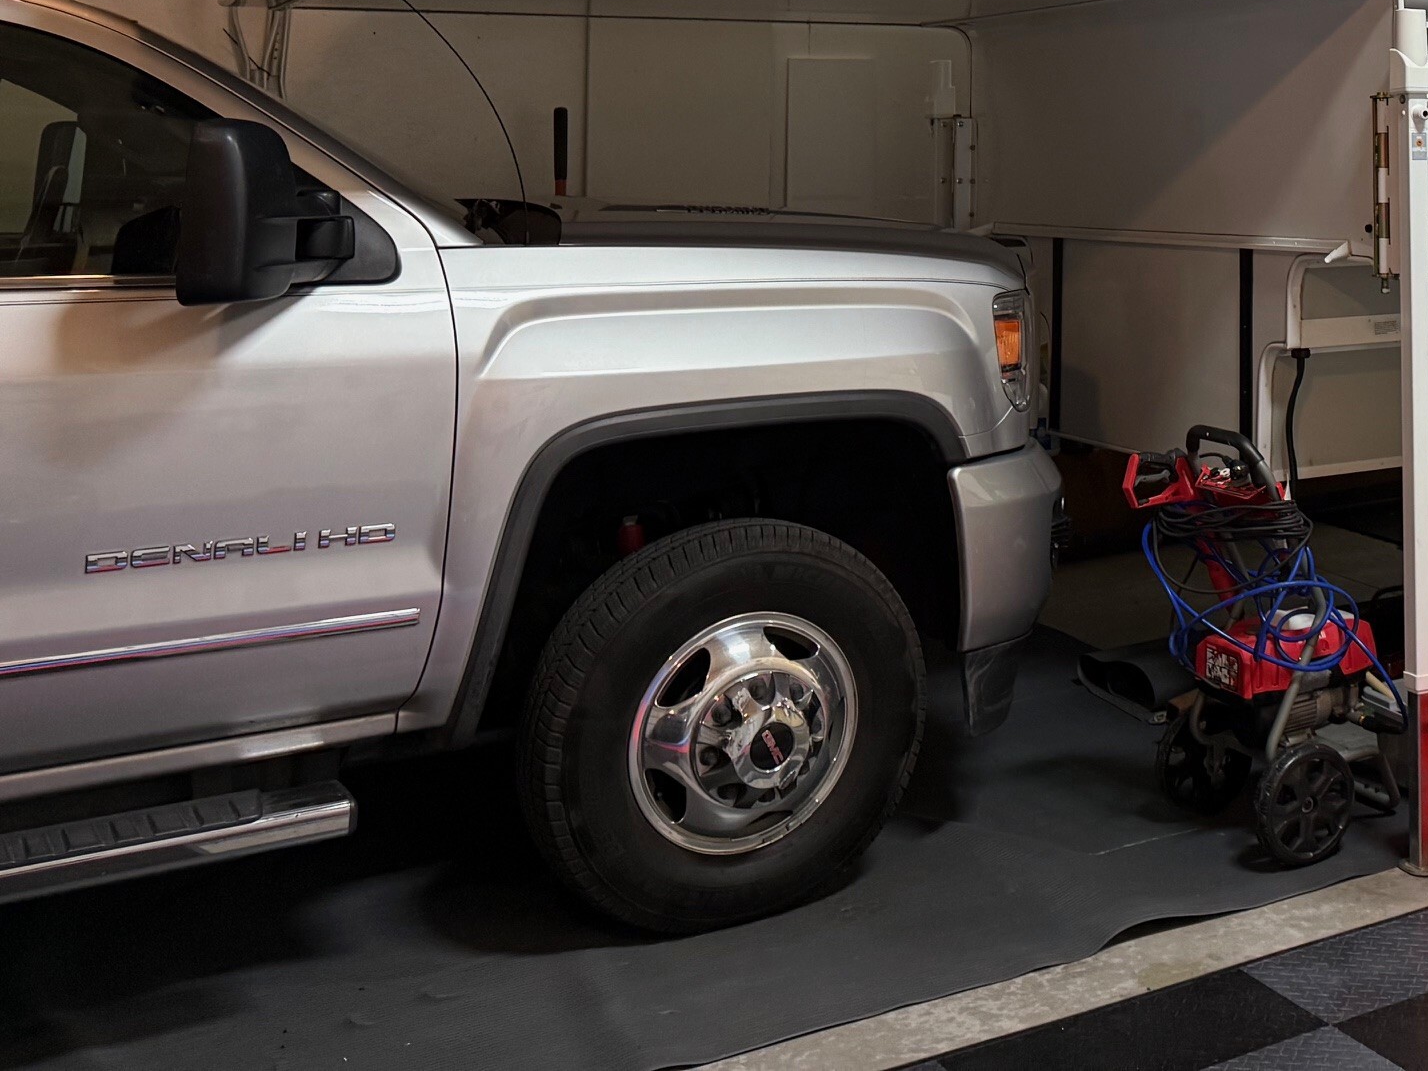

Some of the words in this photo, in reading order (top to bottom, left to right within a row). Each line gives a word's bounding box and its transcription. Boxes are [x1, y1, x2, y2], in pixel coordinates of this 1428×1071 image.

[85, 530, 307, 574] DENALI
[317, 523, 395, 549] HD
[762, 730, 784, 765] GMC
